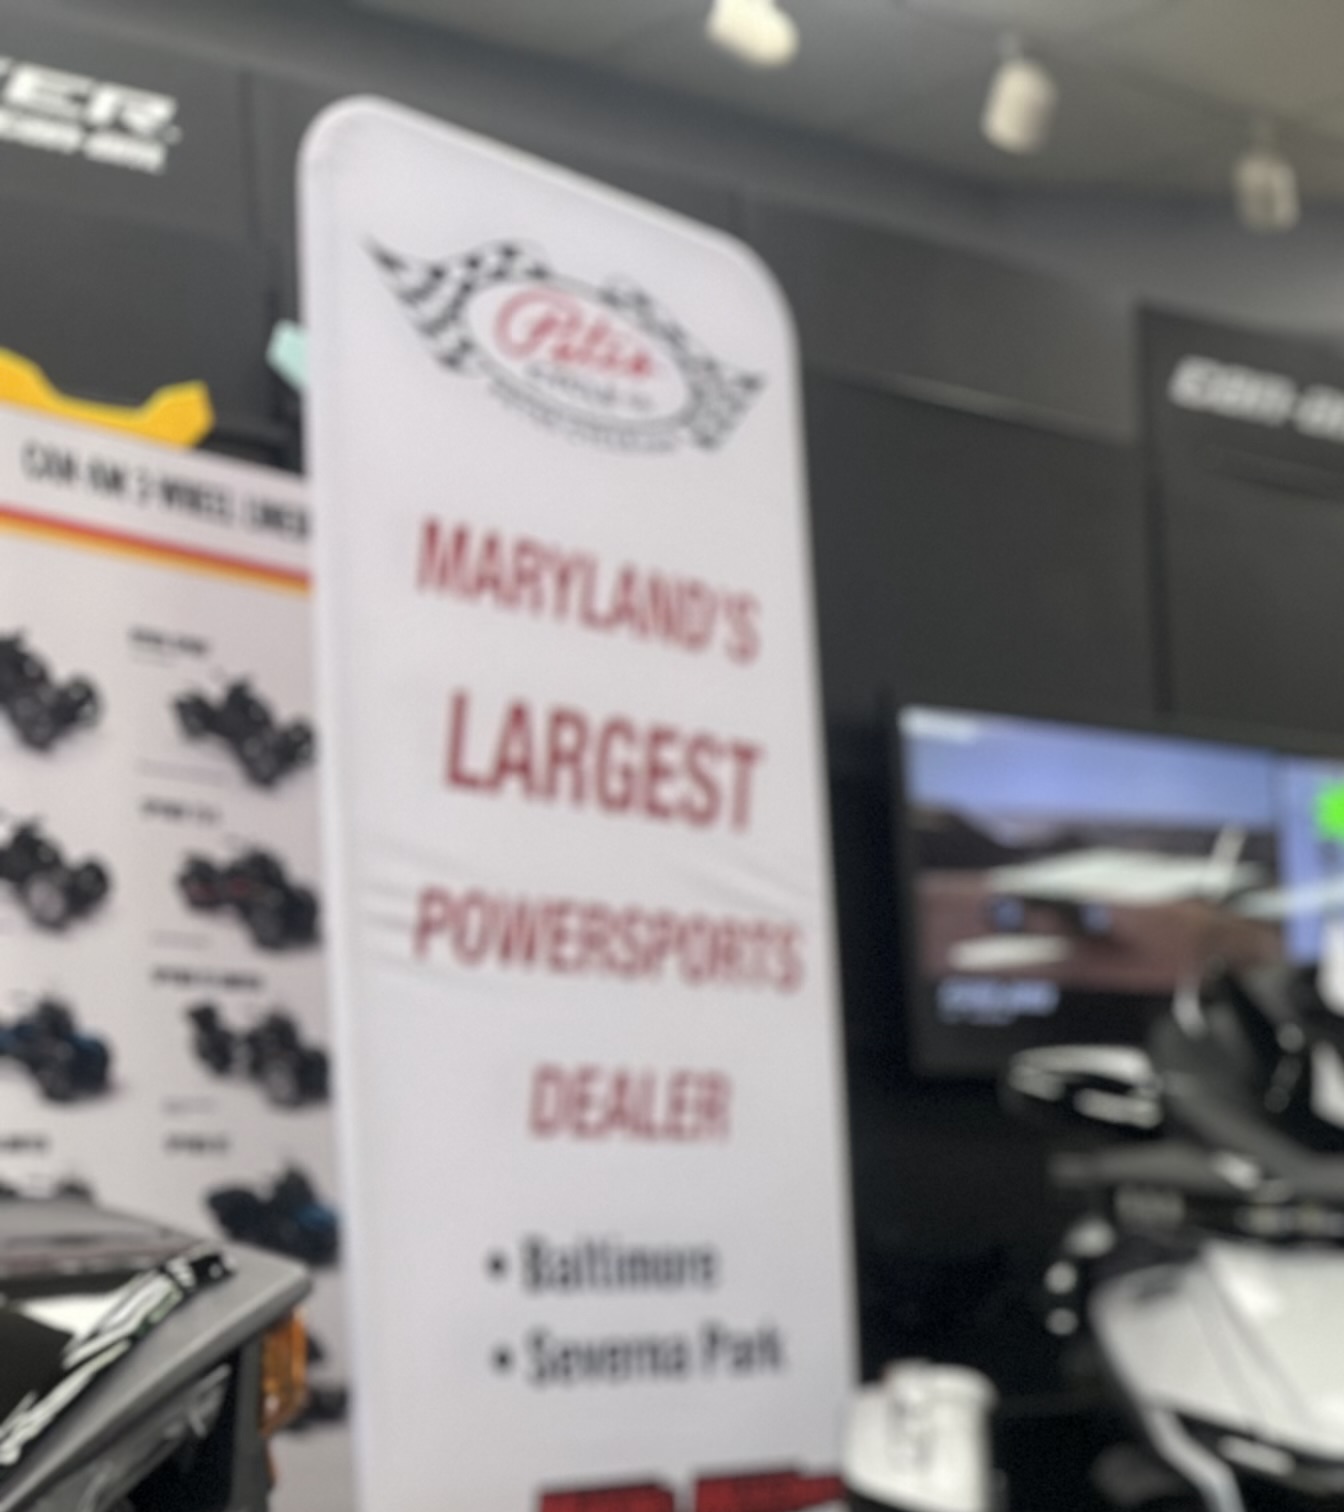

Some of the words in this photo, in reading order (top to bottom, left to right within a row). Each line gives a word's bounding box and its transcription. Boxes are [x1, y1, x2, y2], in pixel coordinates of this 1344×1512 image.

[415, 514, 761, 666] MARYLAND'S
[444, 688, 765, 833] LARGEST
[412, 887, 805, 994] POWERSPORTS
[525, 1062, 733, 1144] DEALER
[519, 1232, 719, 1295] Baltimore
[525, 1326, 690, 1390] Severna
[698, 1316, 784, 1378] Park
